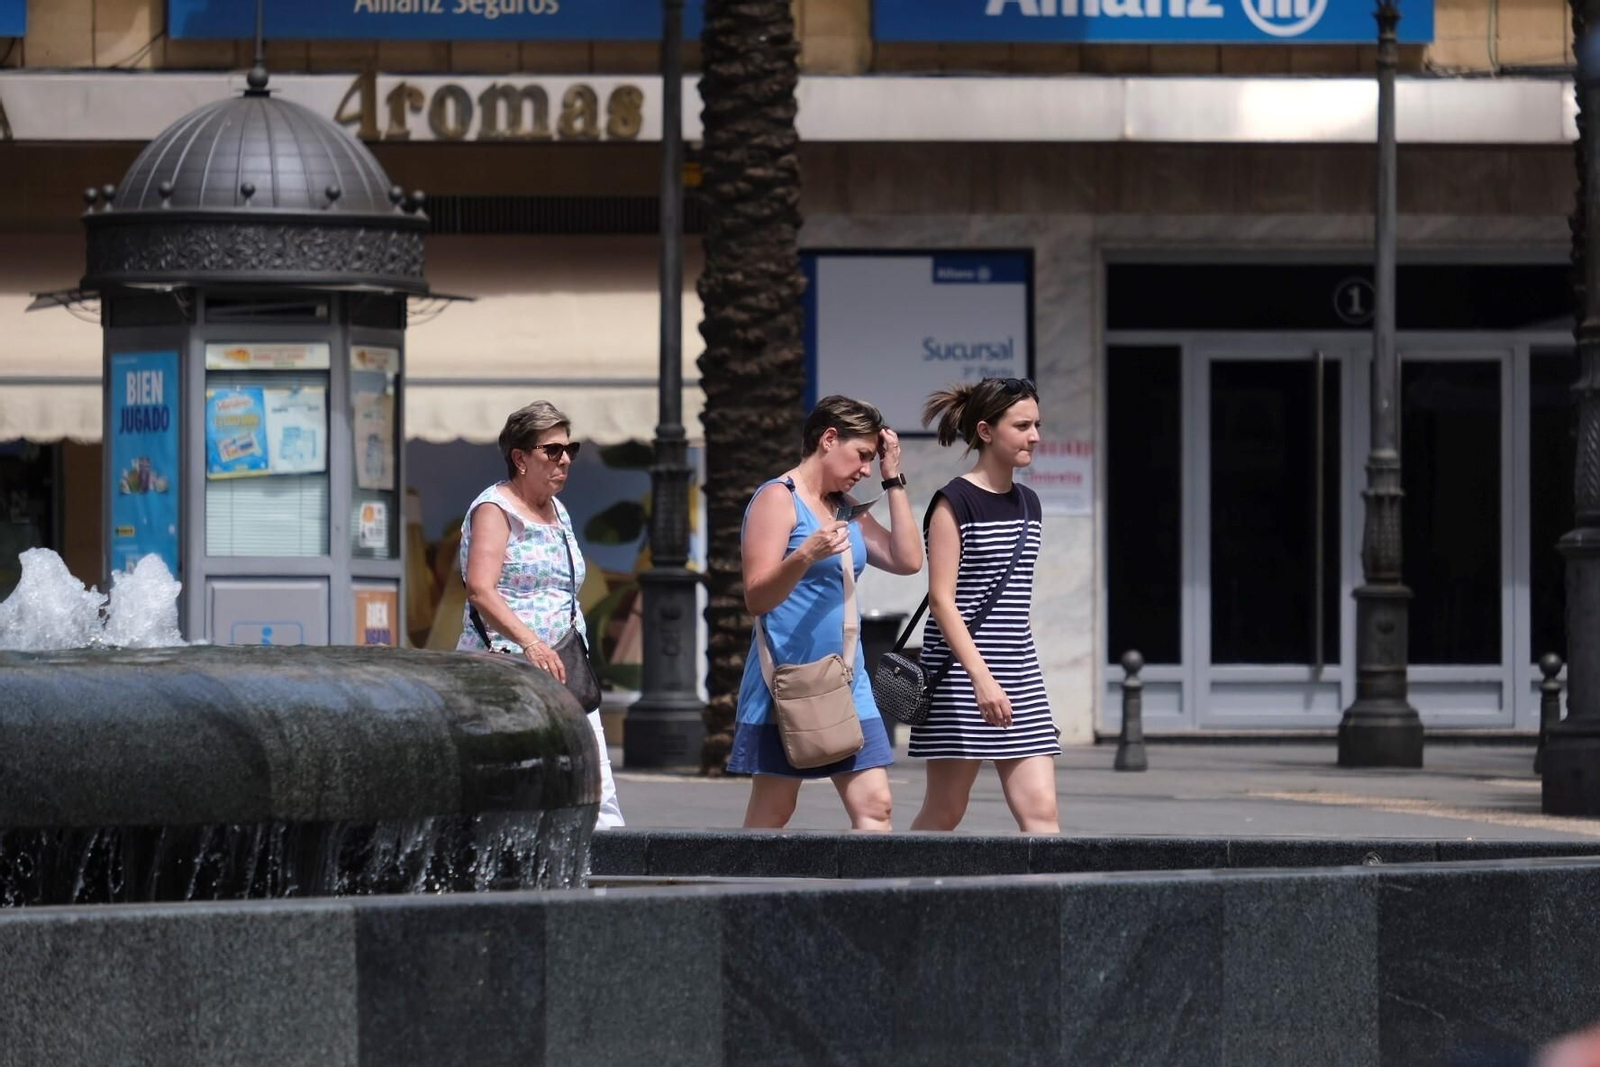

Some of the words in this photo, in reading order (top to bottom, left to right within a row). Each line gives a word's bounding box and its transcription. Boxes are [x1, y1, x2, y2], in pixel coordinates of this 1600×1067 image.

[452, 0, 559, 19] Seguros
[334, 67, 645, 140] Aromas
[1348, 285, 1366, 315] 1
[922, 335, 1014, 361] Sucursal
[126, 370, 164, 405] BIEN
[119, 404, 170, 435] JUGADO
